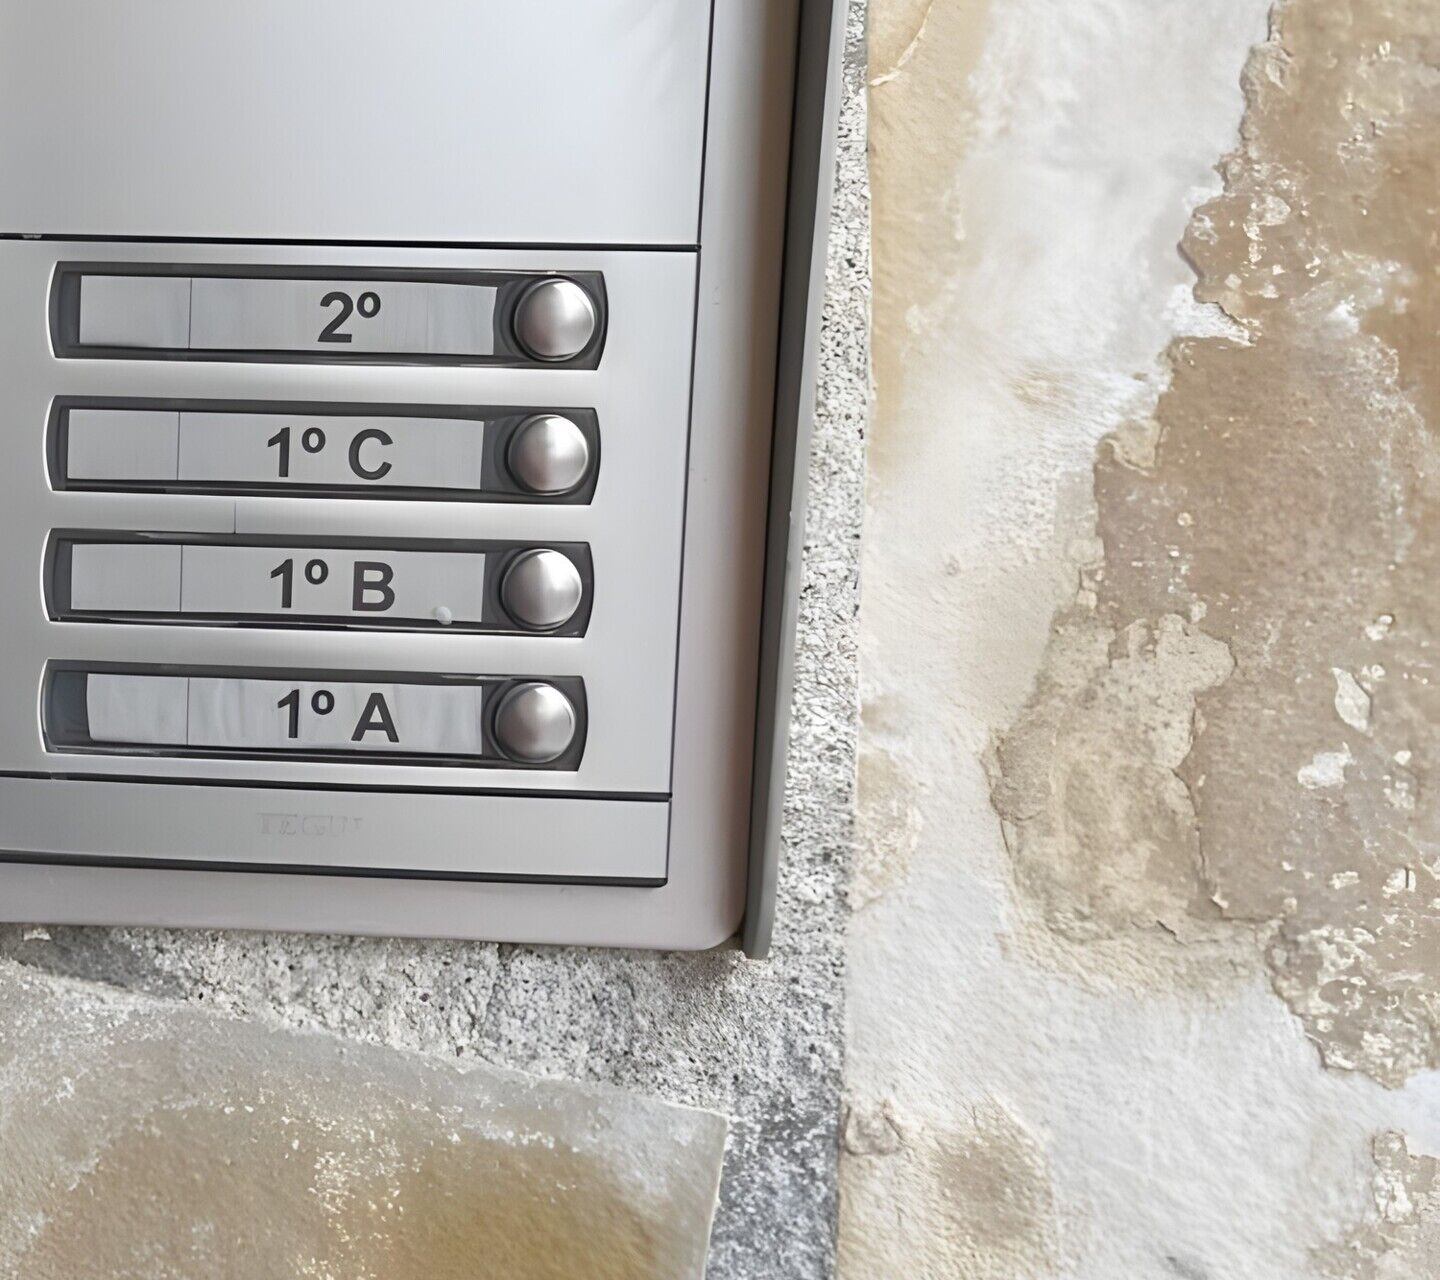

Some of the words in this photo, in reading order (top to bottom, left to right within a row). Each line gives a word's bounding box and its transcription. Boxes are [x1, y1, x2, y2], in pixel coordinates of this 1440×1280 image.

[317, 291, 382, 344] 2º
[266, 426, 327, 479] 1º
[347, 427, 394, 481] C
[269, 557, 330, 610] 1º
[352, 560, 396, 612] B
[276, 688, 336, 740] 1º
[350, 691, 400, 743] A
